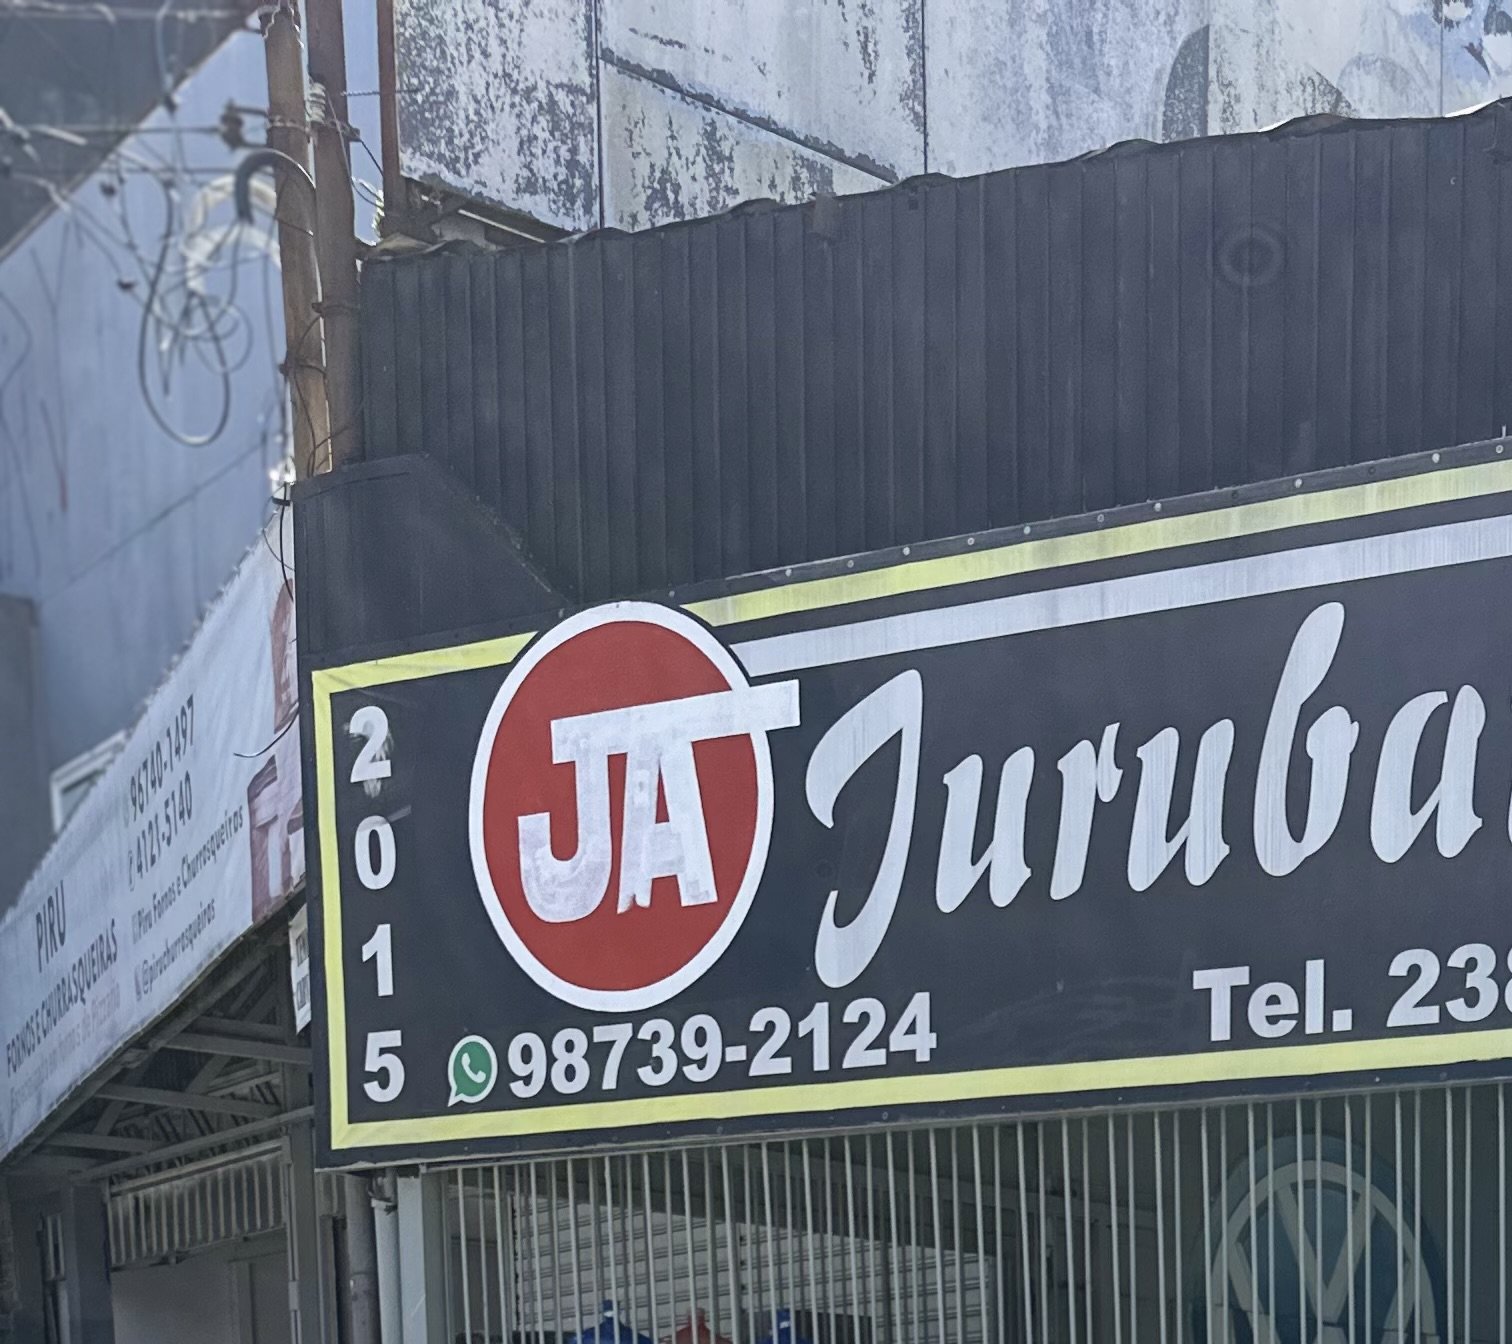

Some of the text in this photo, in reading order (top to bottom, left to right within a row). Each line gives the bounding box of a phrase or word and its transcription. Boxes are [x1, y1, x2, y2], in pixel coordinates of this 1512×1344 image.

[36, 880, 66, 973] PIRU
[41, 918, 118, 1038] CHURRASQUEIRAS
[1193, 958, 1353, 1041] Tel.
[508, 991, 937, 1098] 98739-2124
